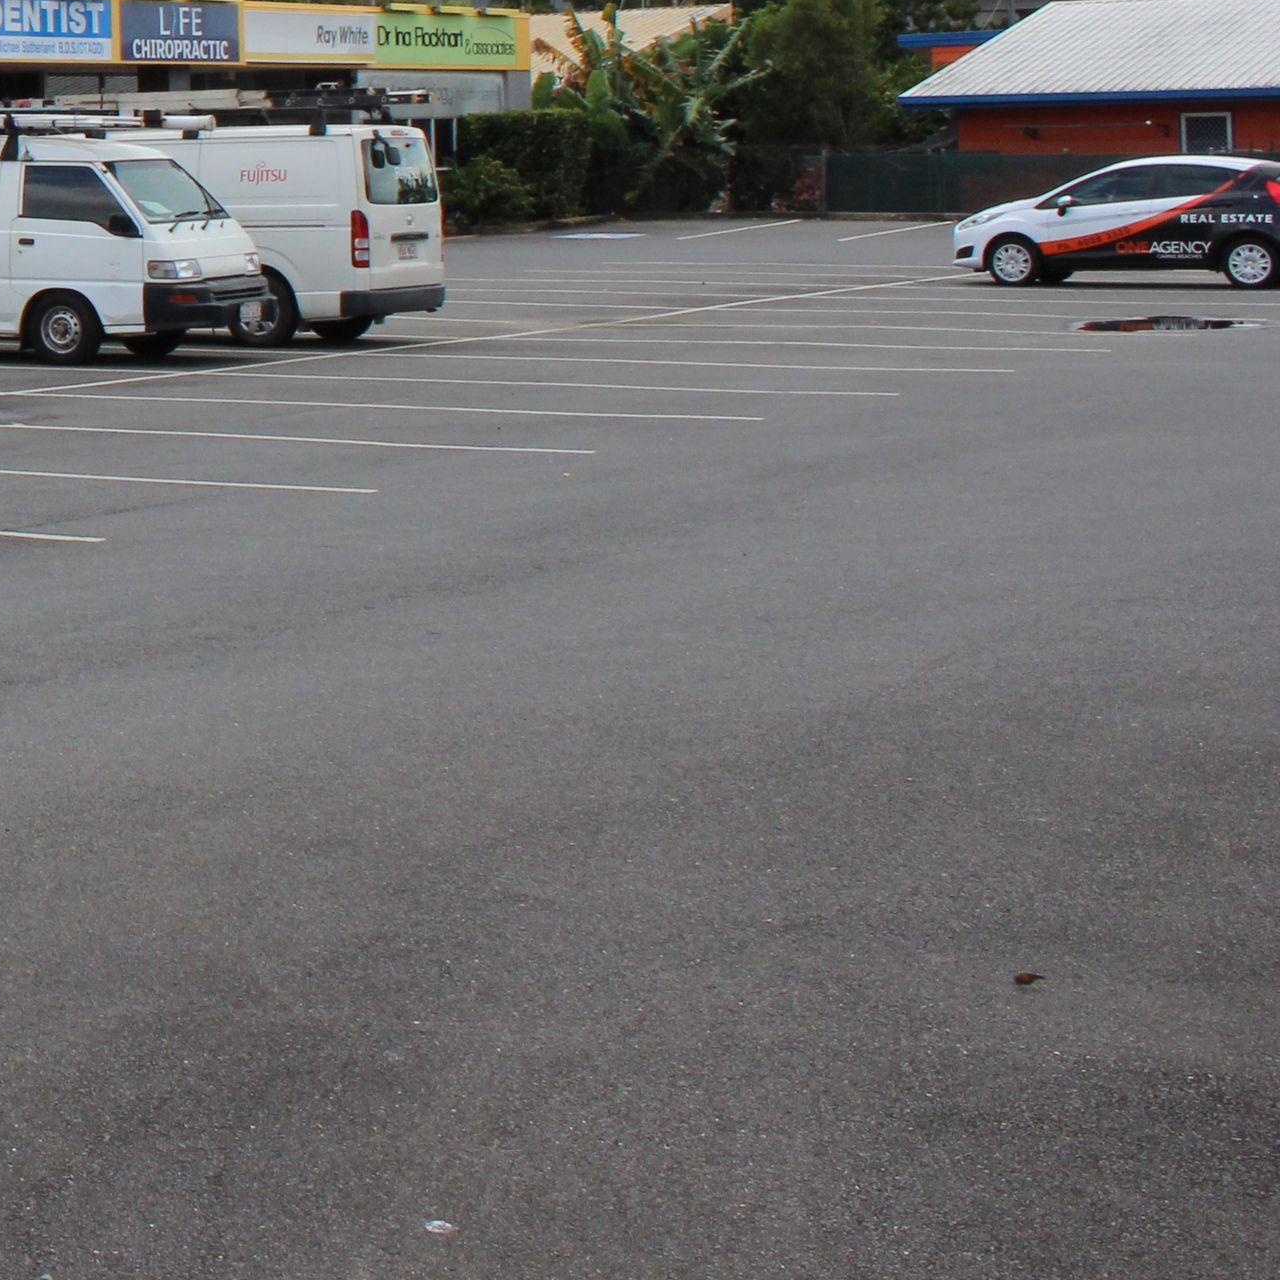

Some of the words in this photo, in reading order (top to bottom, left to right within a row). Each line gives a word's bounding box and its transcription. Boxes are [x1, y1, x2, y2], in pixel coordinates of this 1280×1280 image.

[316, 25, 337, 48] Ray
[340, 26, 368, 45] White
[377, 26, 391, 46] Dr
[395, 26, 411, 47] Ina
[415, 26, 463, 48] Flockhart
[132, 38, 229, 60] CHIROPRACTIC
[240, 167, 287, 185] FUJITSU
[1181, 214, 1215, 223] REAL
[1221, 214, 1273, 223] ESTATE
